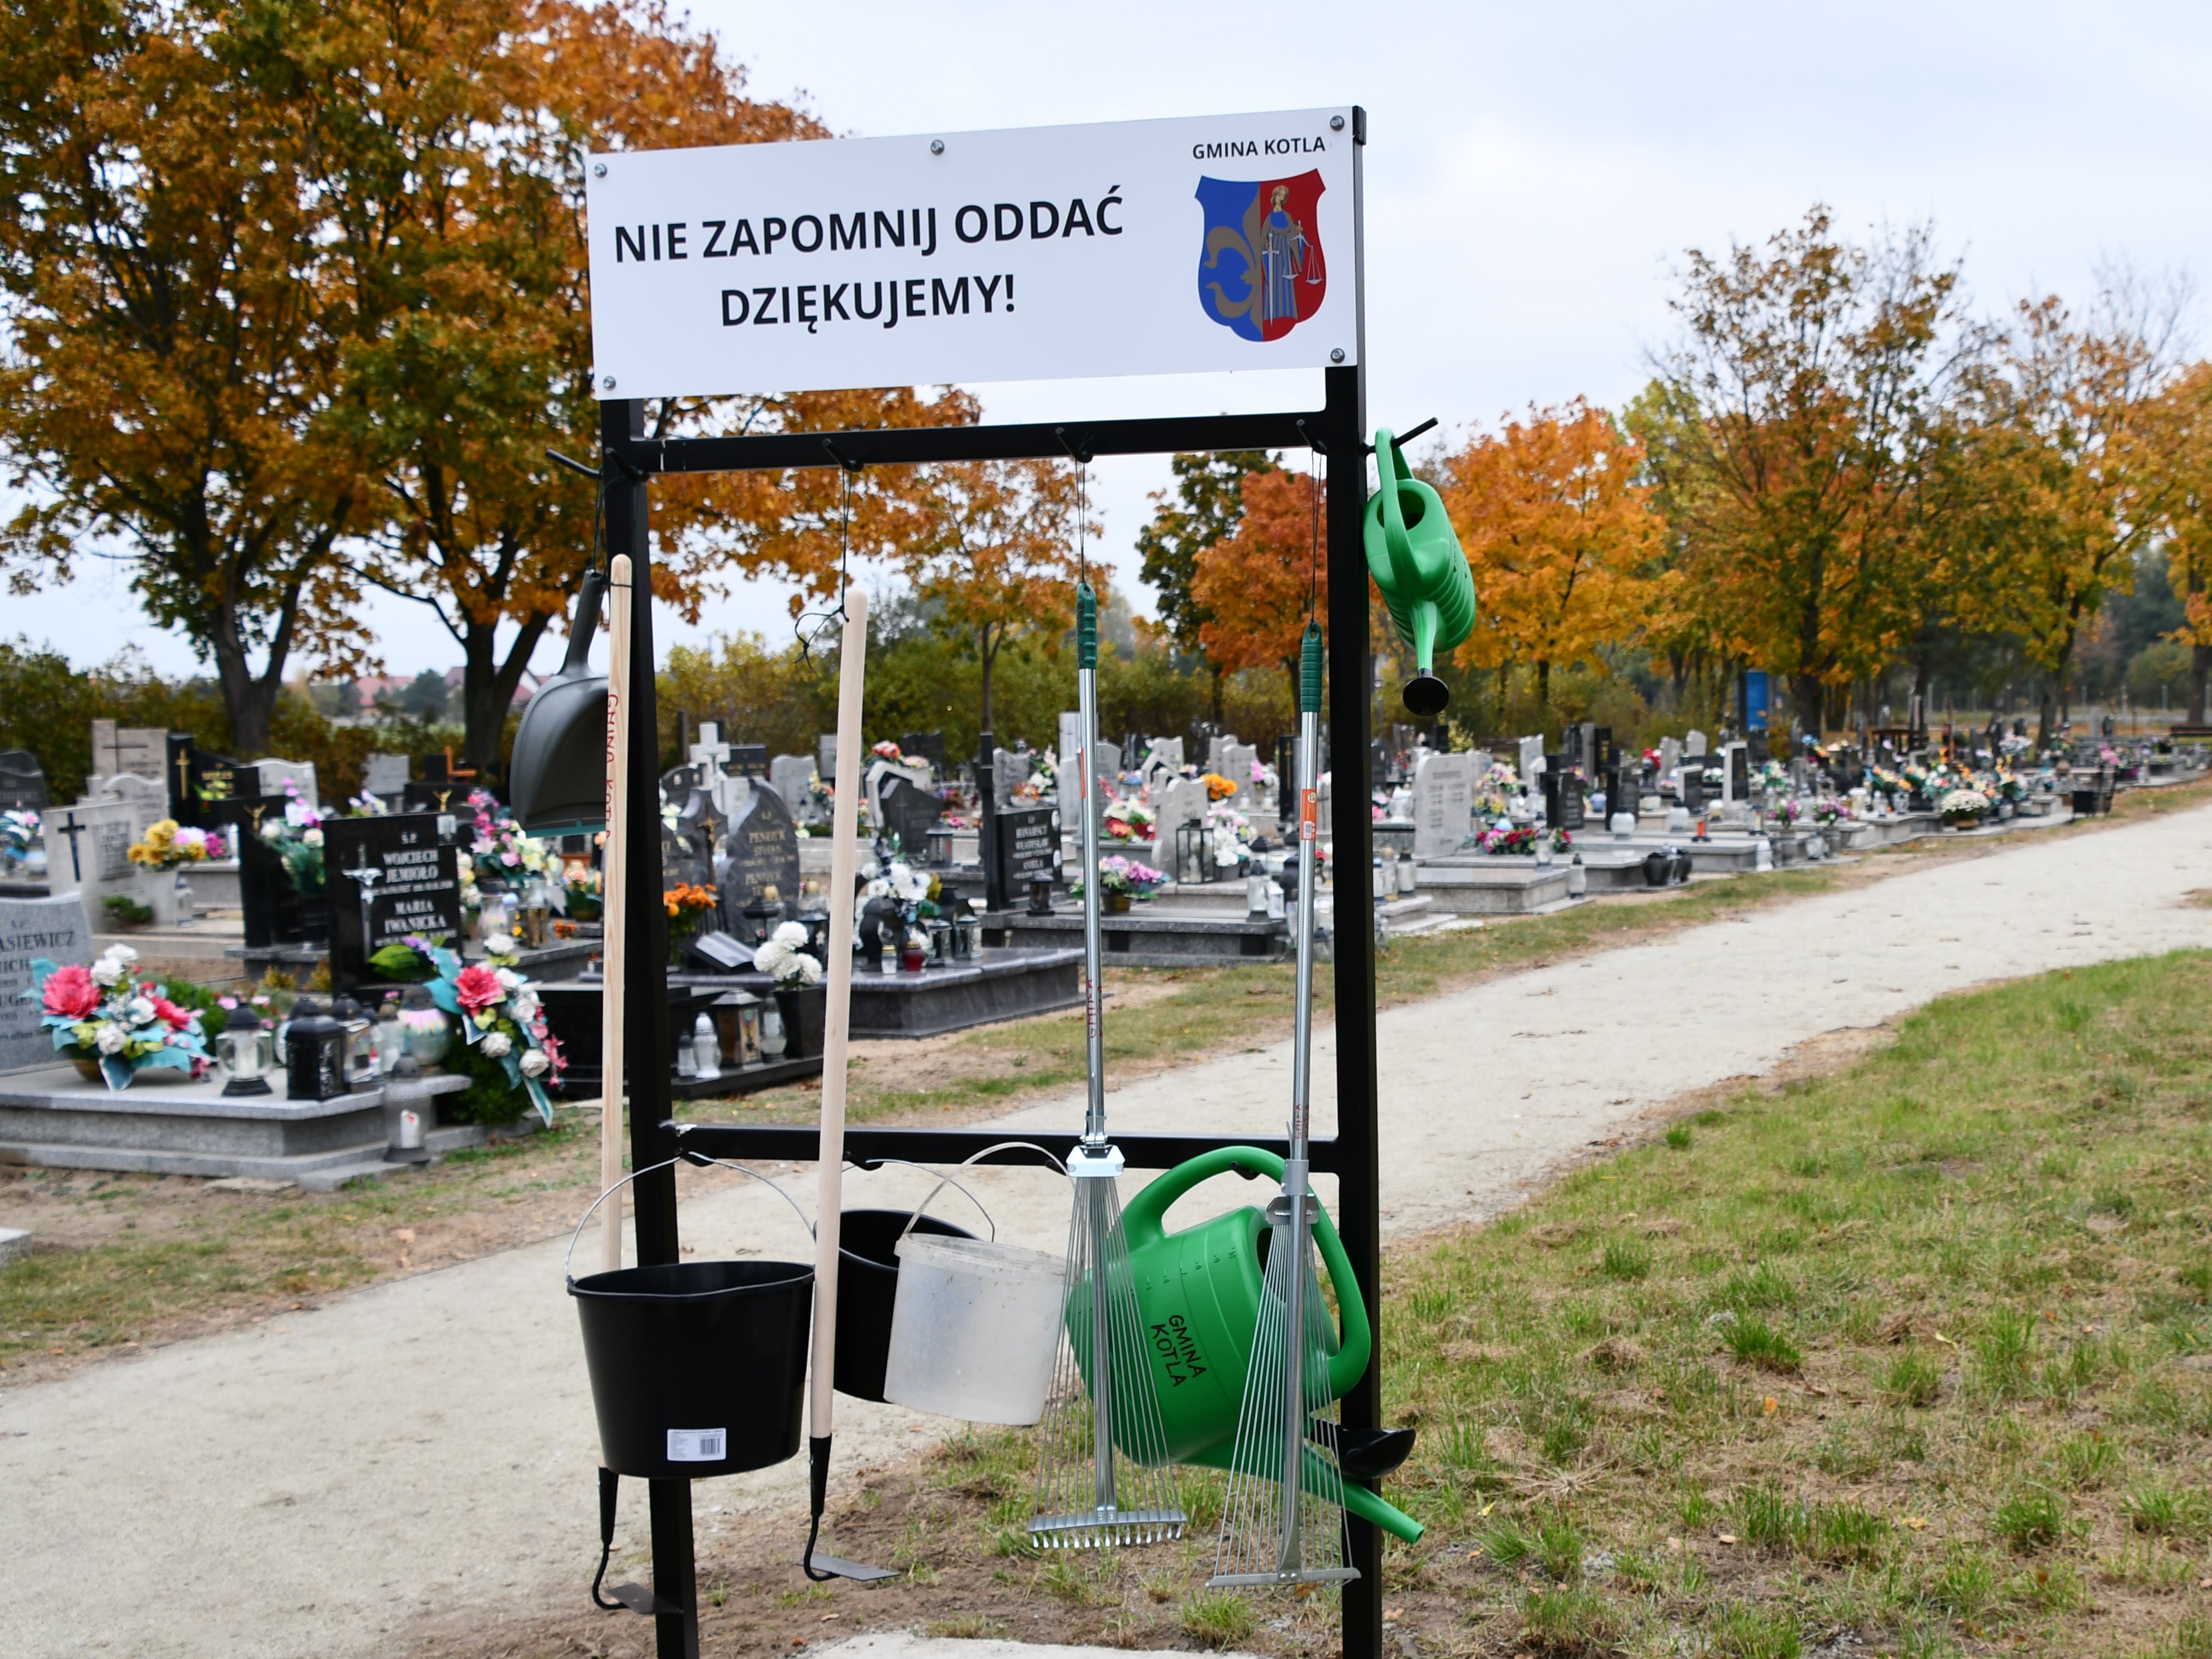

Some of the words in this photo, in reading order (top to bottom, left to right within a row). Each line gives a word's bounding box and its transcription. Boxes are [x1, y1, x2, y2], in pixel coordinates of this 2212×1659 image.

[1192, 141, 1259, 160] GMINA
[1264, 136, 1326, 155] KOTLA
[615, 222, 688, 263] NIE
[702, 208, 936, 259] ZAPOMNIJ
[954, 184, 1123, 244] ODDAĆ
[721, 274, 1015, 334] DZIĘKUJEMY!
[607, 693, 619, 764] GMINA
[1150, 1323, 1187, 1388] KOTLA
[1168, 1314, 1207, 1378] GMINA
